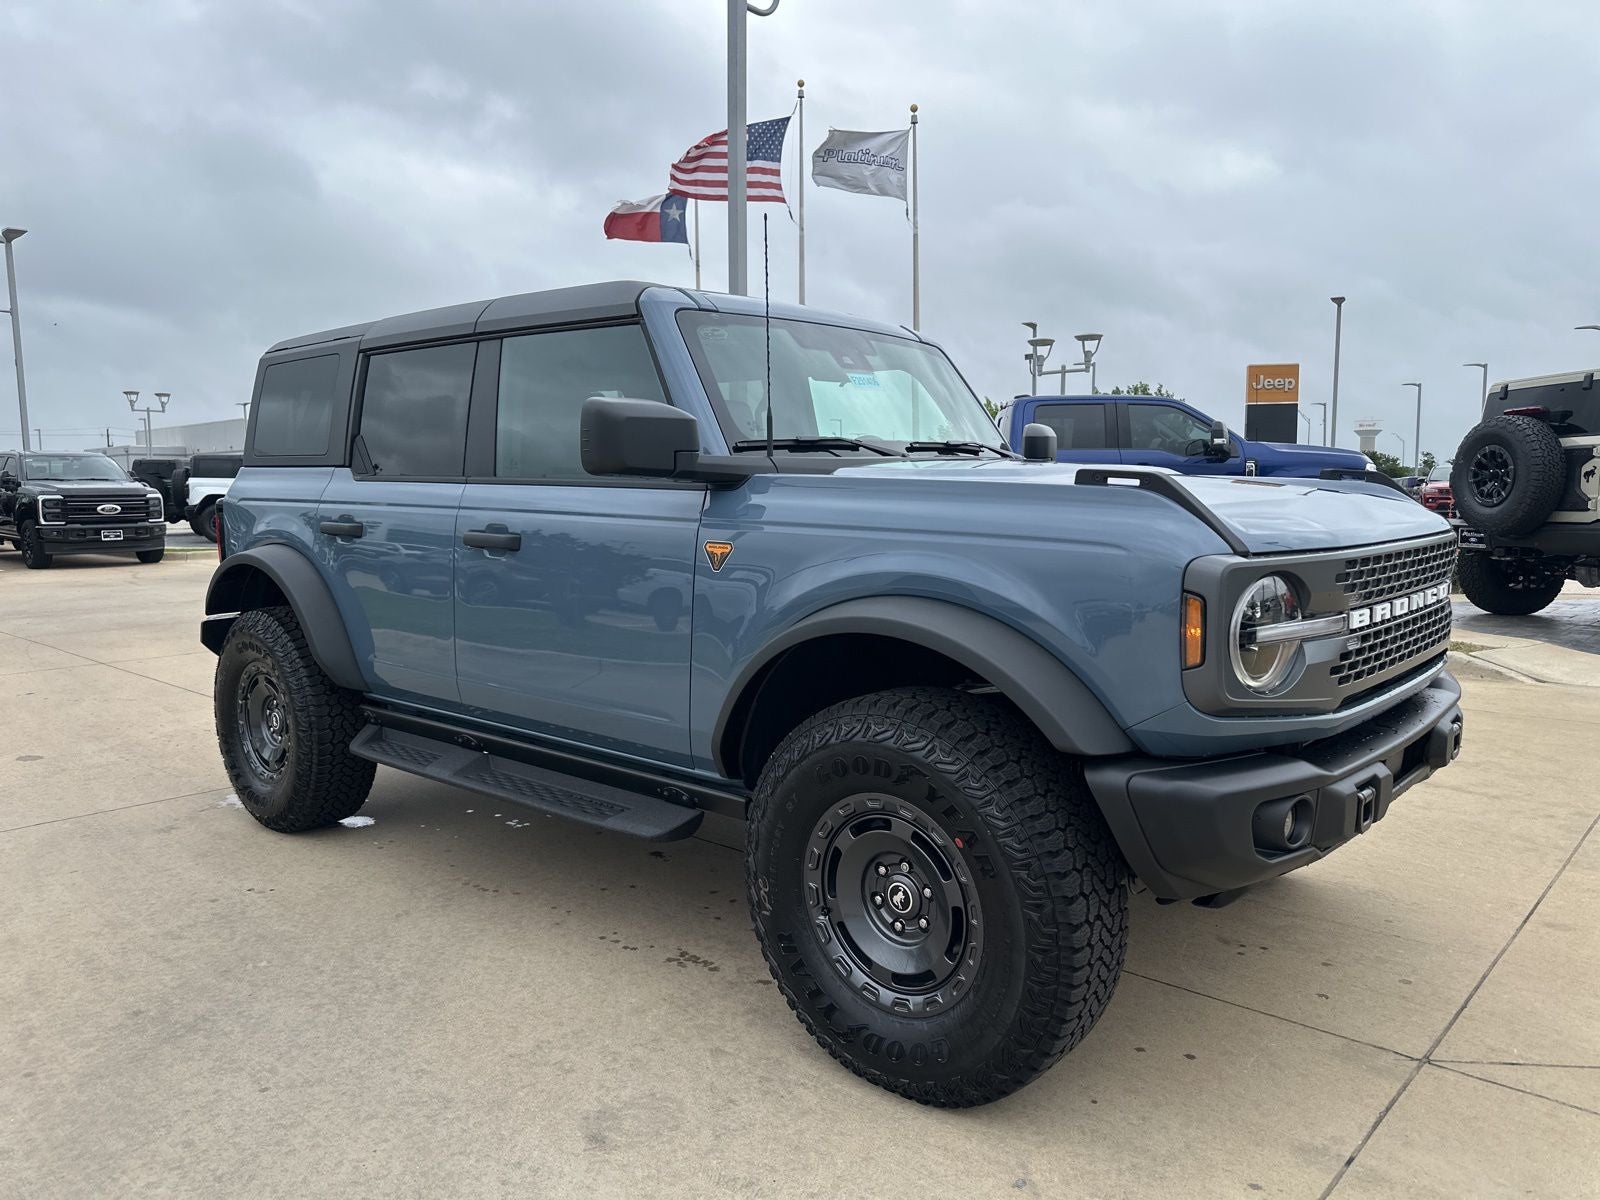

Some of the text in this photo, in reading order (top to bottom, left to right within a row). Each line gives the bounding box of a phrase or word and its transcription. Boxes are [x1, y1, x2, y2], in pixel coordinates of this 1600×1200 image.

[818, 148, 904, 171] Platinum
[1252, 375, 1296, 392] Jeep
[1349, 581, 1452, 629] BRONCO
